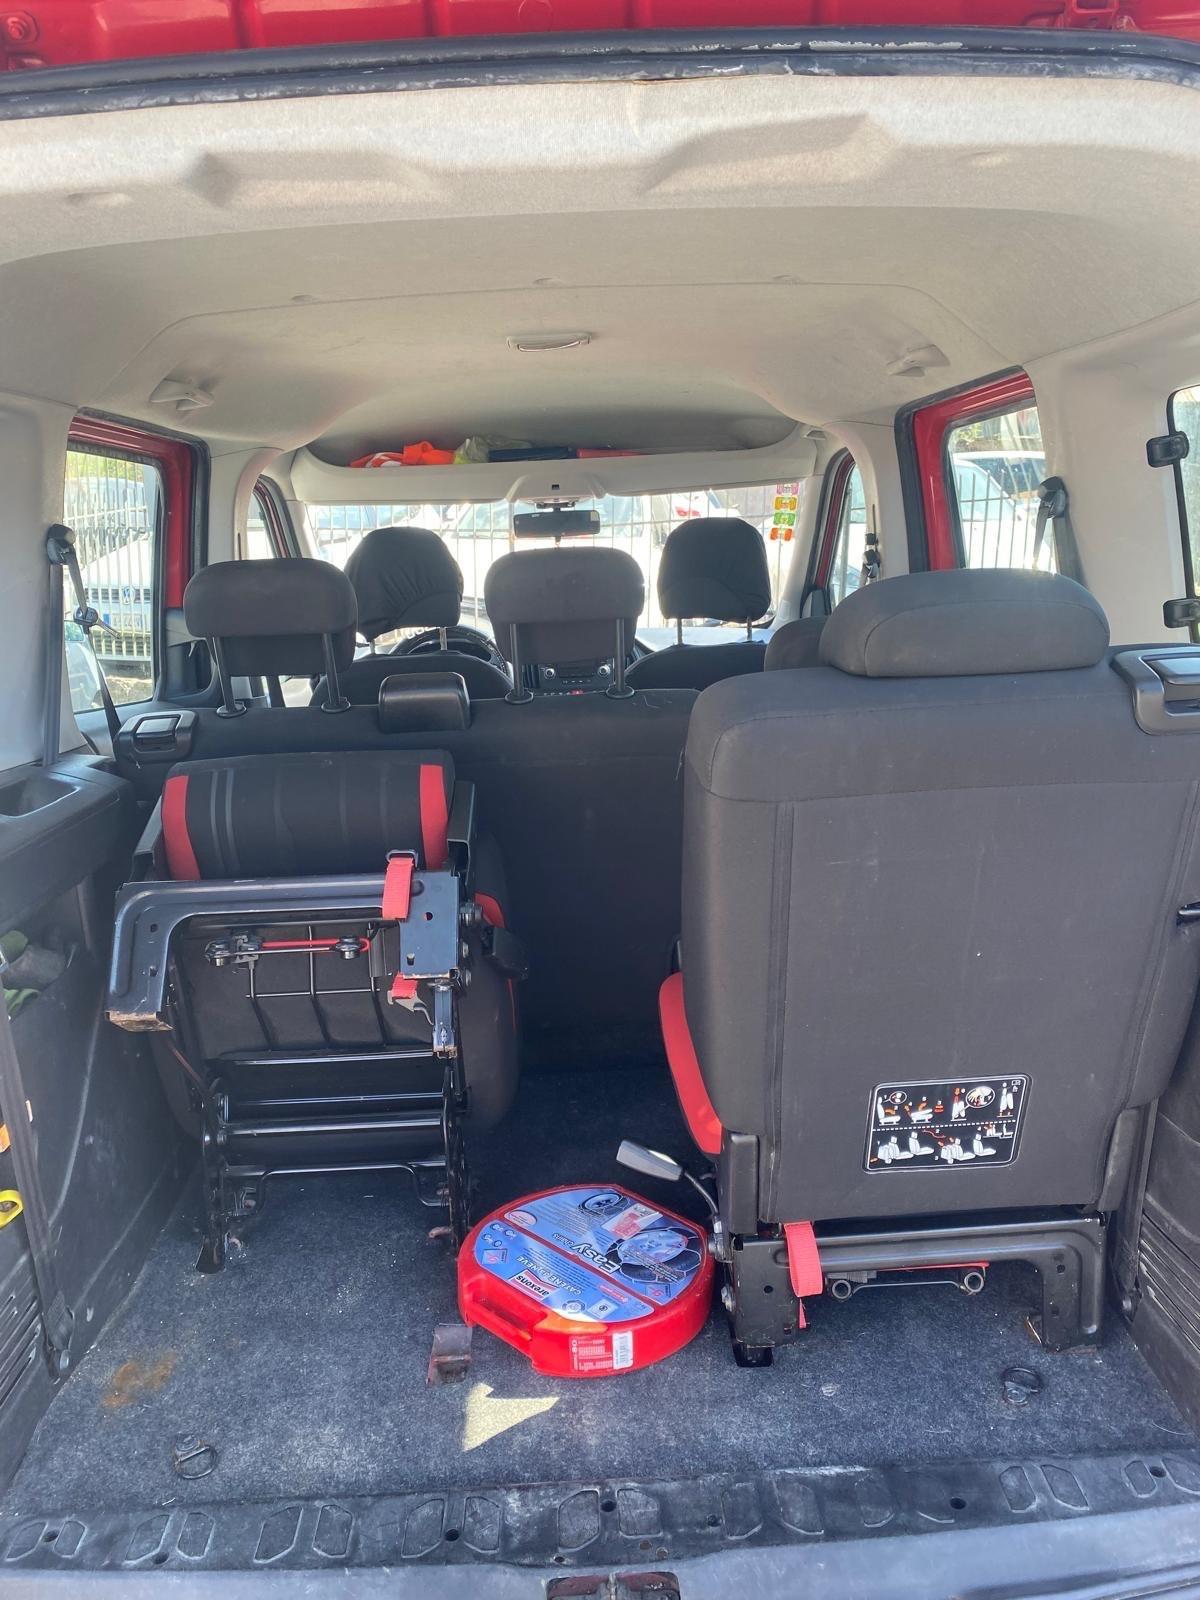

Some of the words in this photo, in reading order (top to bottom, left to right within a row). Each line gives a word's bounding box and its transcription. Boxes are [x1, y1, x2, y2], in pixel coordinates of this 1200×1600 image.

[552, 1232, 575, 1247] chains
[516, 1256, 540, 1274] NEVE
[571, 1242, 621, 1275] Easy
[515, 1274, 550, 1297] arexons
[549, 1274, 582, 1296] CATENE
